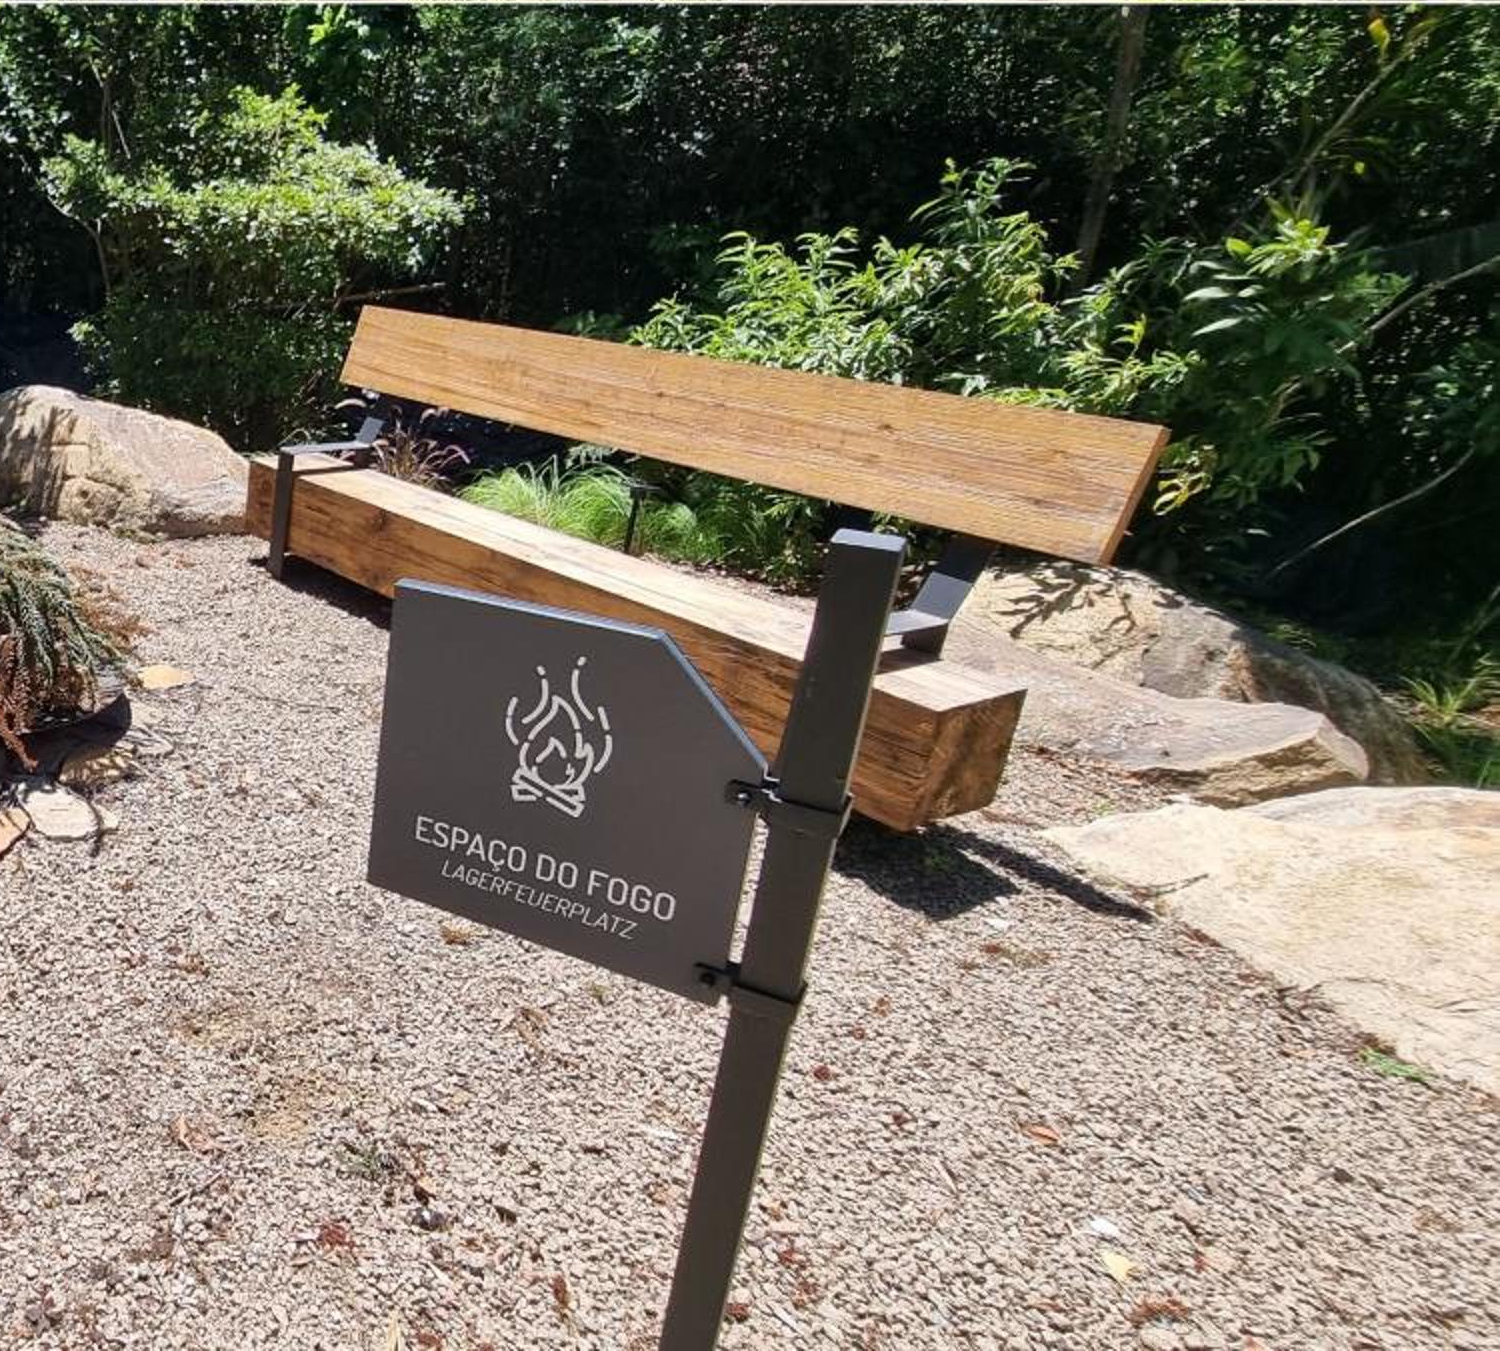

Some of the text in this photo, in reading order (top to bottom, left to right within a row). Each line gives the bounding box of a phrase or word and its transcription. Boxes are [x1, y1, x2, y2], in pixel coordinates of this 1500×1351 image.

[415, 815, 677, 921] ESPAÇO DO FOGO
[441, 860, 639, 940] LAGERFEUERPLATZ
